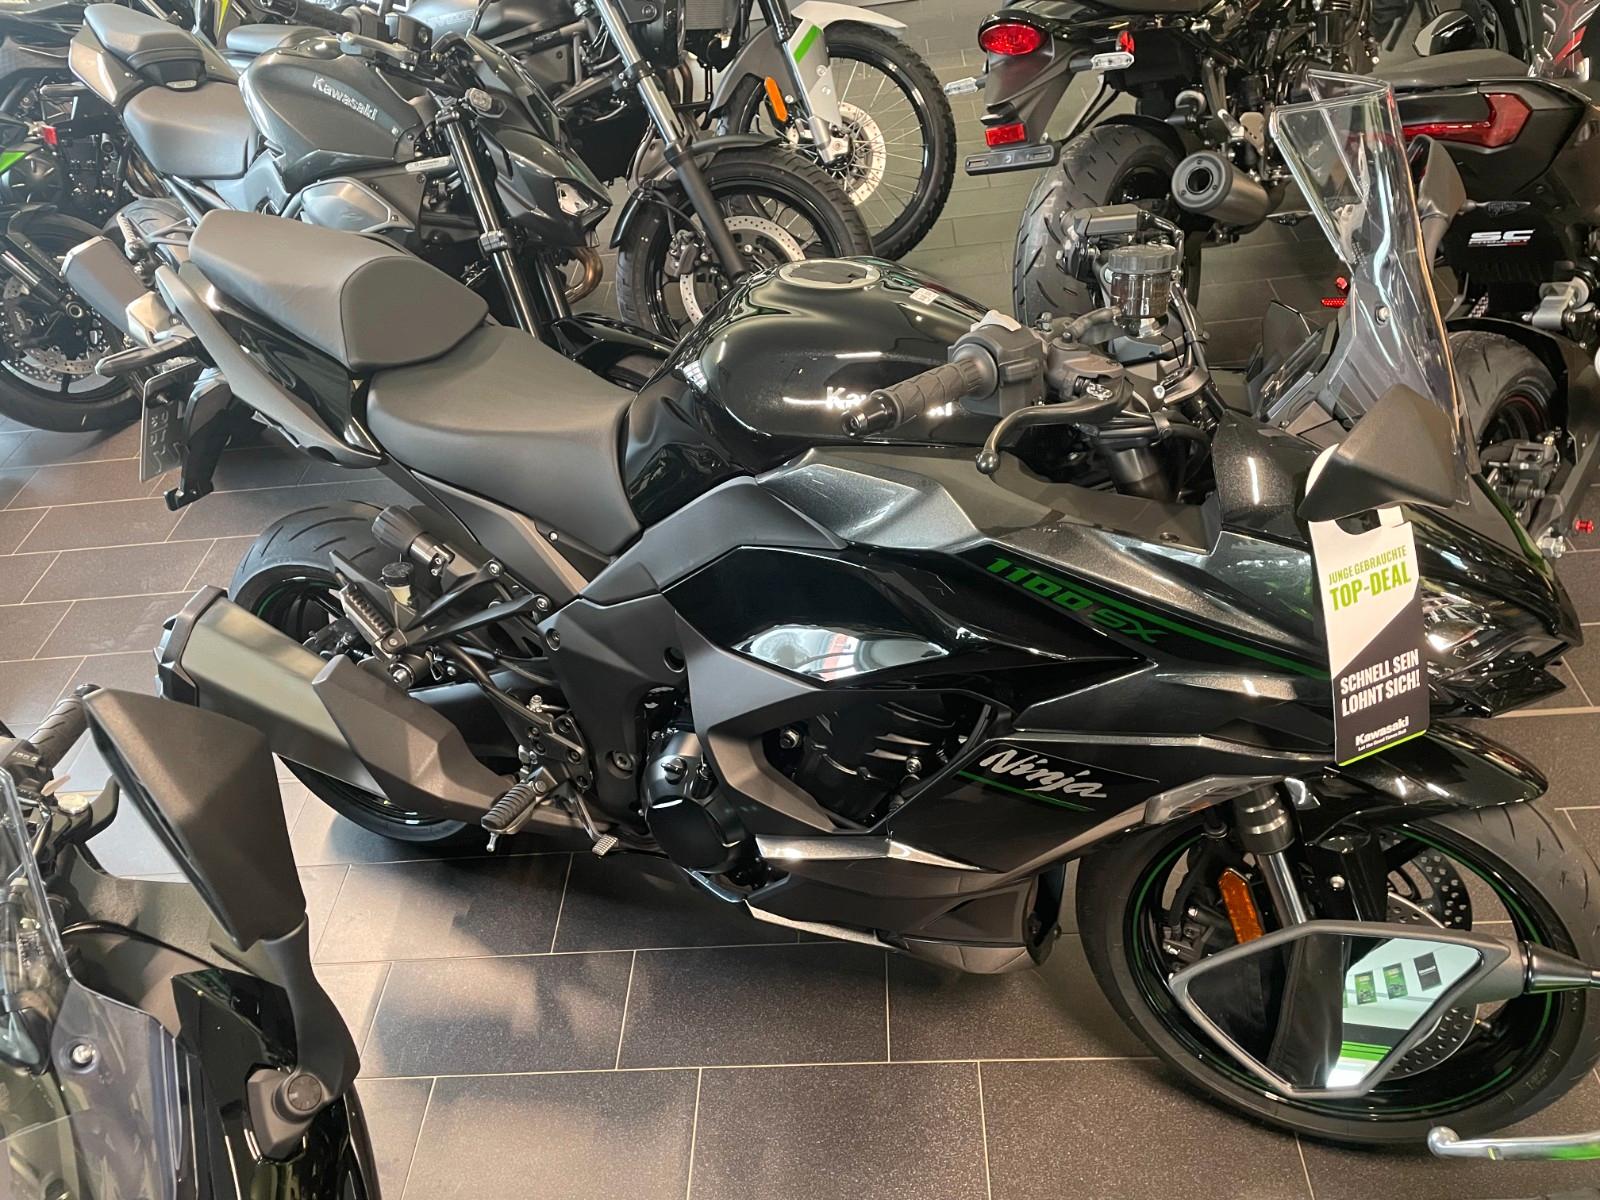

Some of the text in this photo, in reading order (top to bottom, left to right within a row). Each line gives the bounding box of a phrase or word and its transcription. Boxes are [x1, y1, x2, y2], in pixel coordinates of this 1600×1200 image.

[312, 74, 378, 121] Kawasaki
[1328, 544, 1407, 586] JUNGE GEBRAUCHTE
[1329, 561, 1412, 612] TOP-DEAL
[1340, 648, 1419, 695] SCHNELL SEIN
[1341, 668, 1421, 717] LOHNT SICH!
[1355, 715, 1409, 746] Kawasaki
[979, 749, 1108, 798] Ninja
